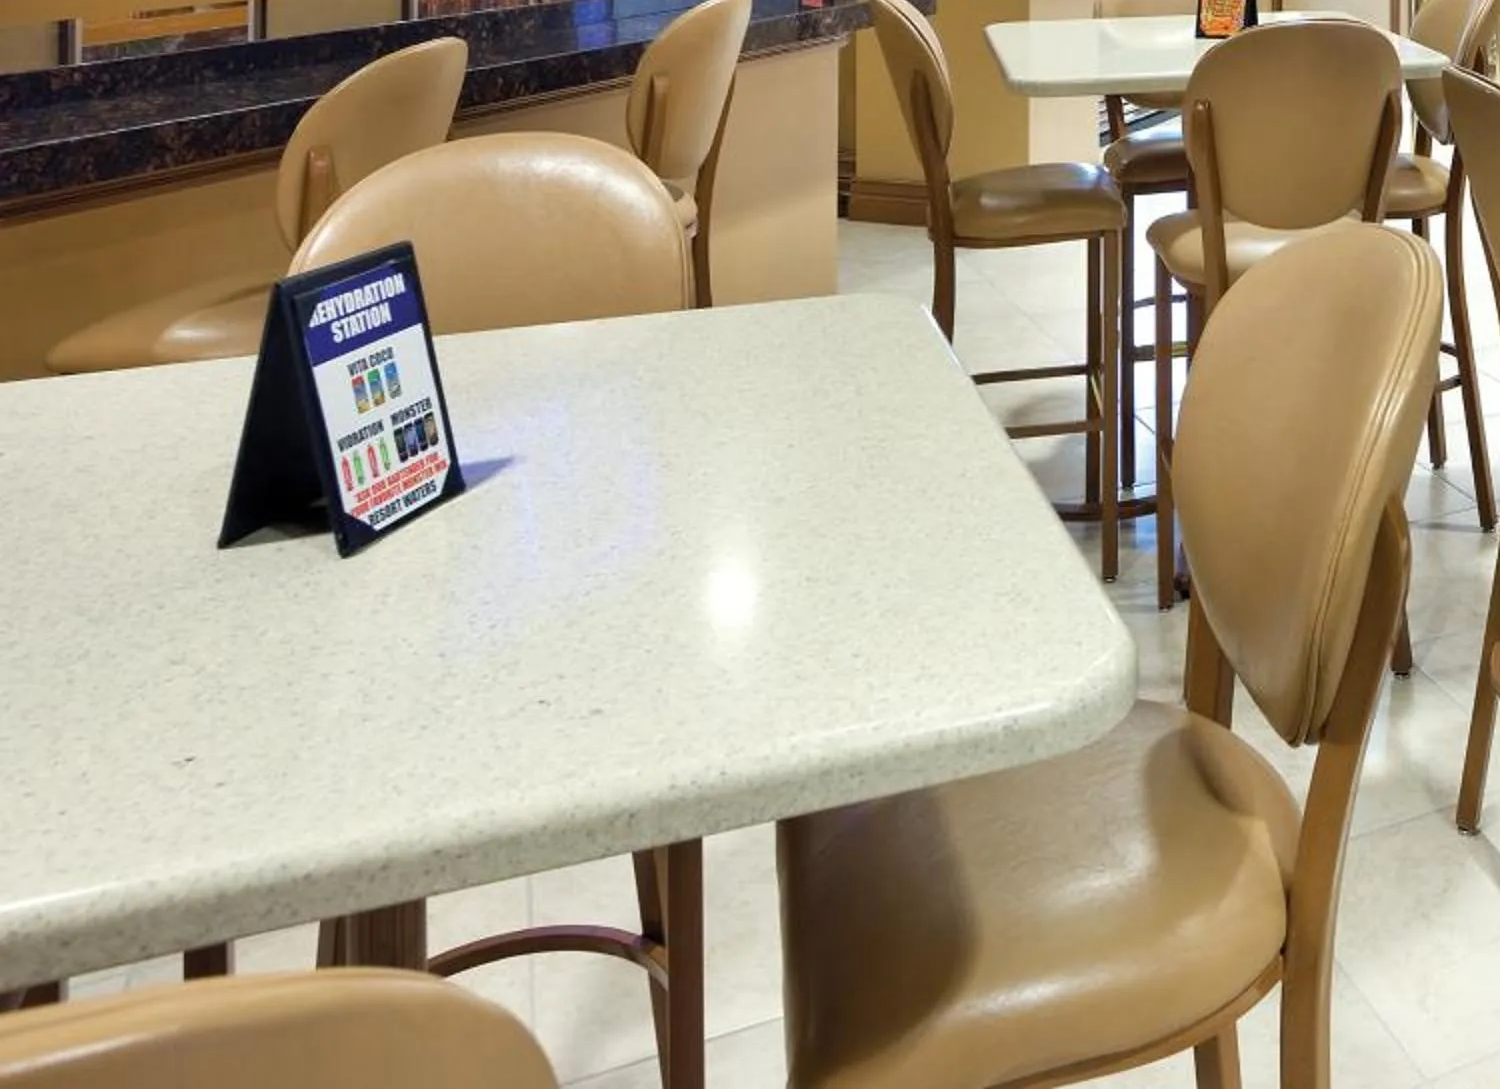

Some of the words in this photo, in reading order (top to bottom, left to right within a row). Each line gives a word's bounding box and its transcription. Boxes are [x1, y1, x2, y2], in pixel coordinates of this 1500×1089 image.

[331, 302, 392, 343] STATION
[390, 397, 432, 426] MONSTER
[368, 498, 402, 525] RESORT
